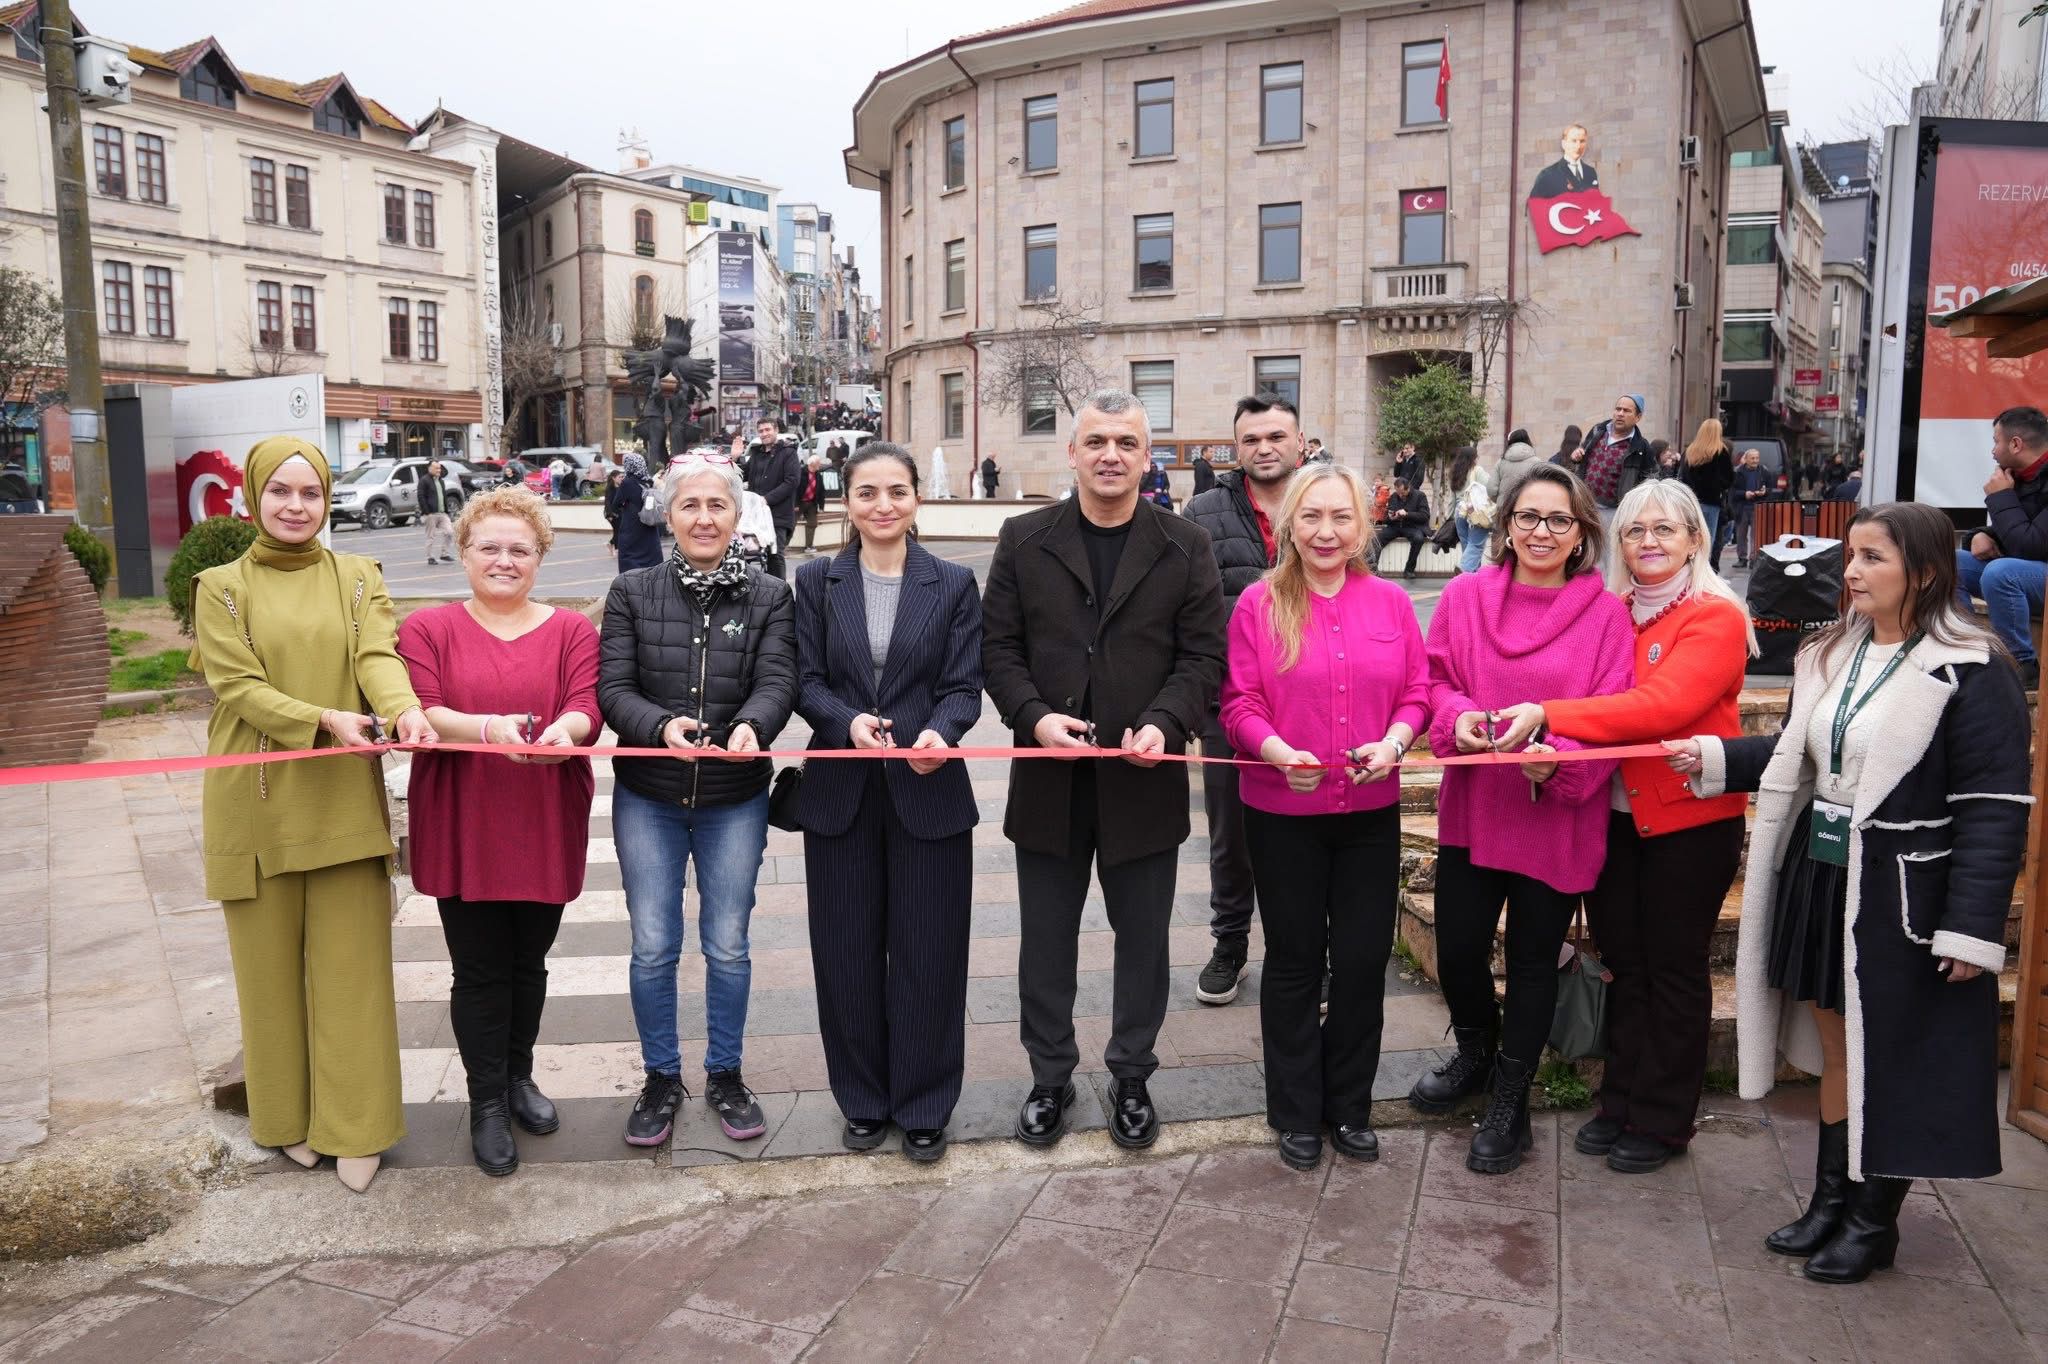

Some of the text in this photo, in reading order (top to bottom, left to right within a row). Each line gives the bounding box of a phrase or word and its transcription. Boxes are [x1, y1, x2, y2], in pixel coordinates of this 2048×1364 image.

[1978, 184, 2048, 201] REZERVA
[1934, 285, 2004, 312] 50
[486, 333, 502, 451] RESTAURANT
